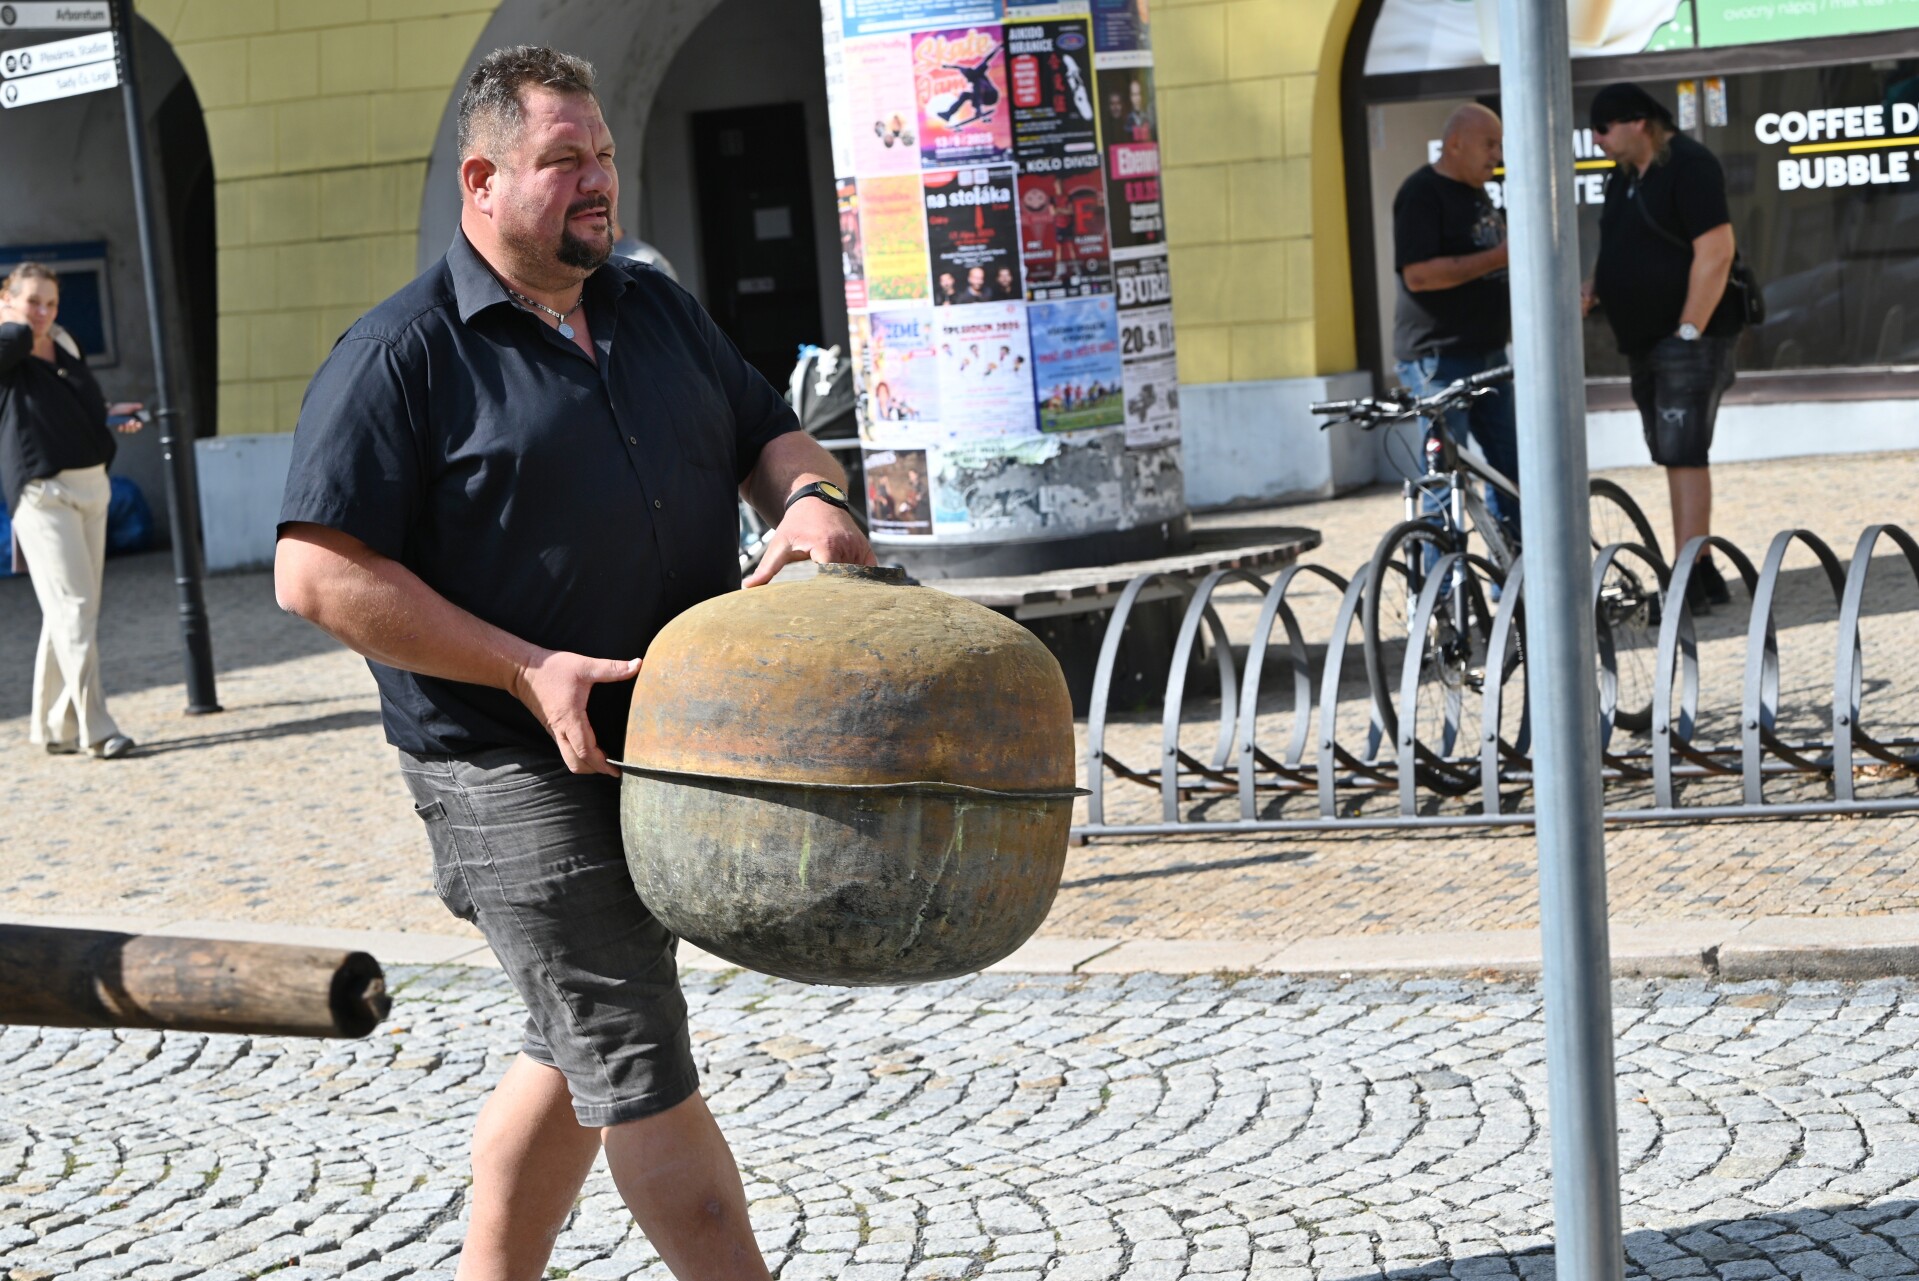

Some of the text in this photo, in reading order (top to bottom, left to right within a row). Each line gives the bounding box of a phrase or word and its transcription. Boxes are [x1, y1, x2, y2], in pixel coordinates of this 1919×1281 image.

[1754, 104, 1886, 145] COFFEE
[1777, 151, 1911, 192] BUBBLE
[927, 193, 948, 209] na
